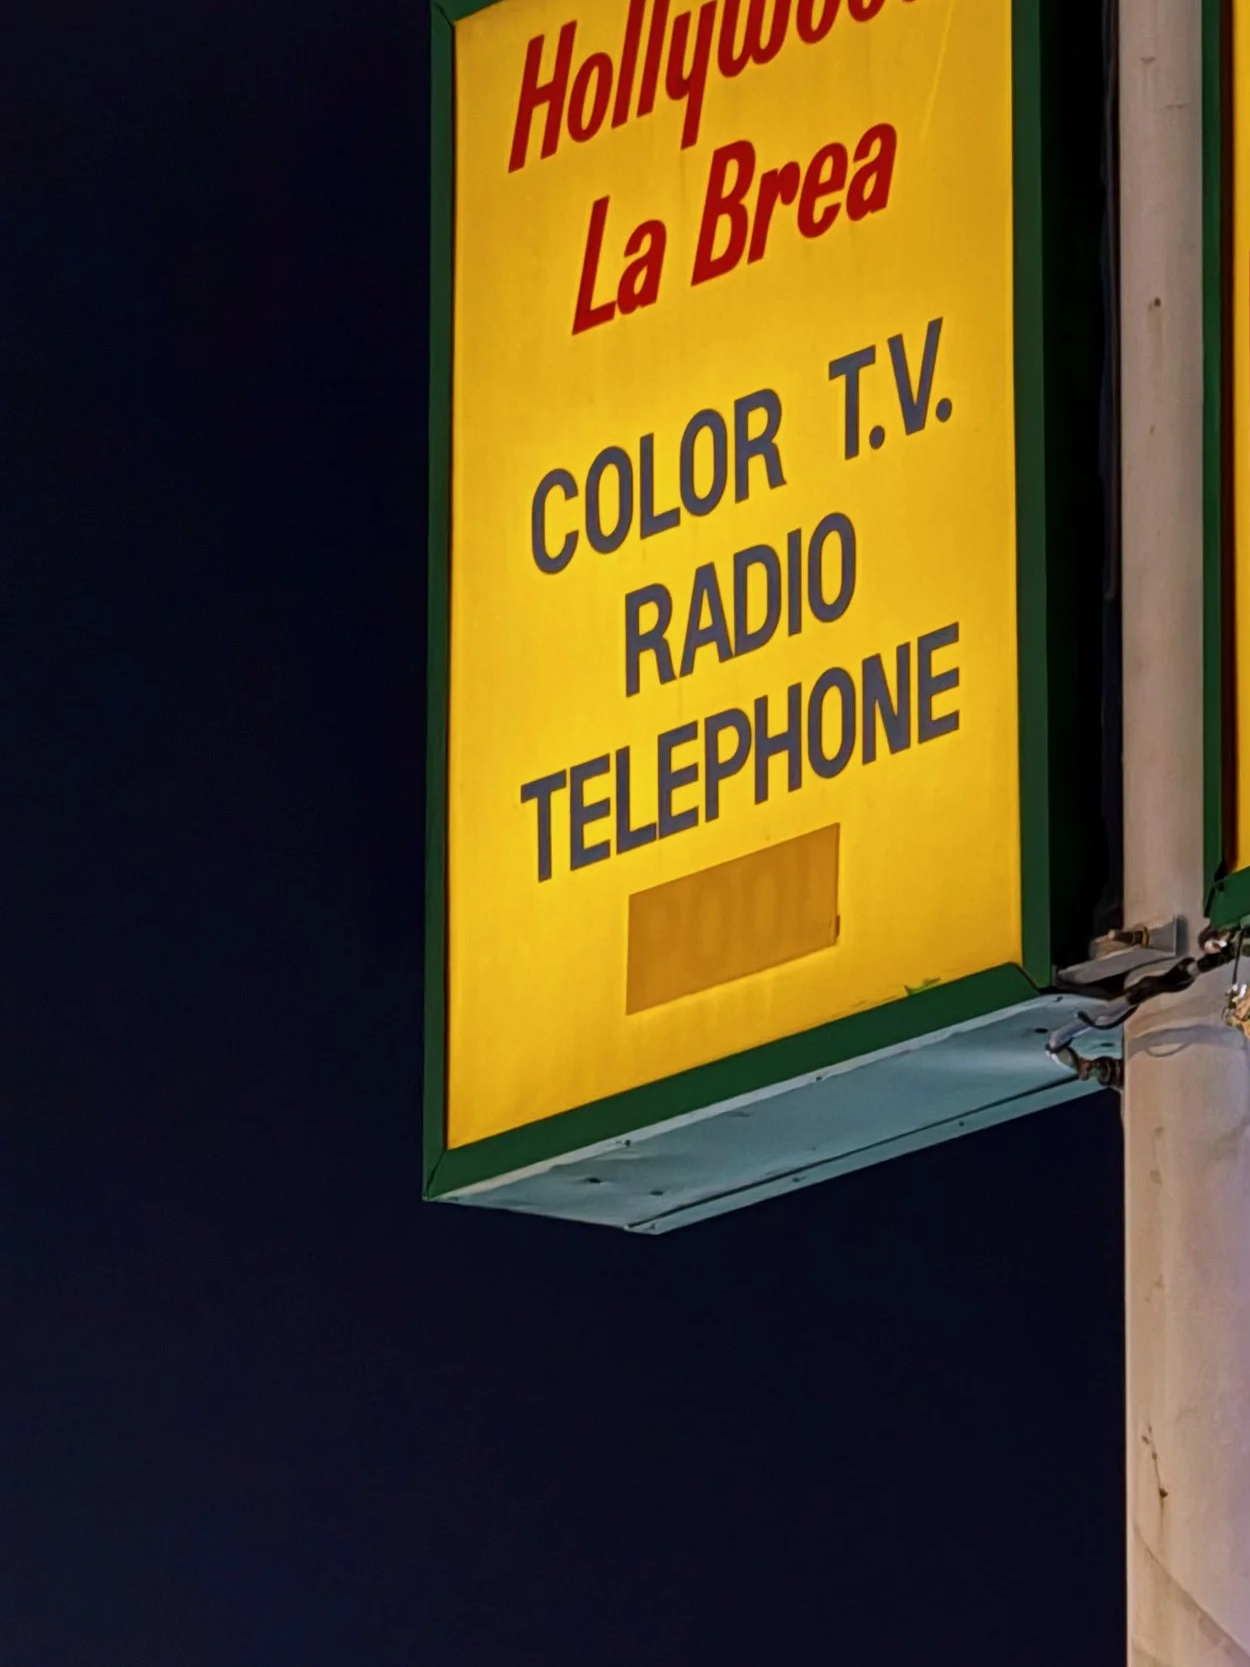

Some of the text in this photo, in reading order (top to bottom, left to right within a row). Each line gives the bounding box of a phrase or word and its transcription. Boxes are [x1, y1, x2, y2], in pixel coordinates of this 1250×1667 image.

[571, 122, 898, 336] La Brea
[531, 317, 953, 575] COLOR T.V.
[624, 512, 857, 698] RADIO
[520, 621, 960, 883] TELEPHONE
